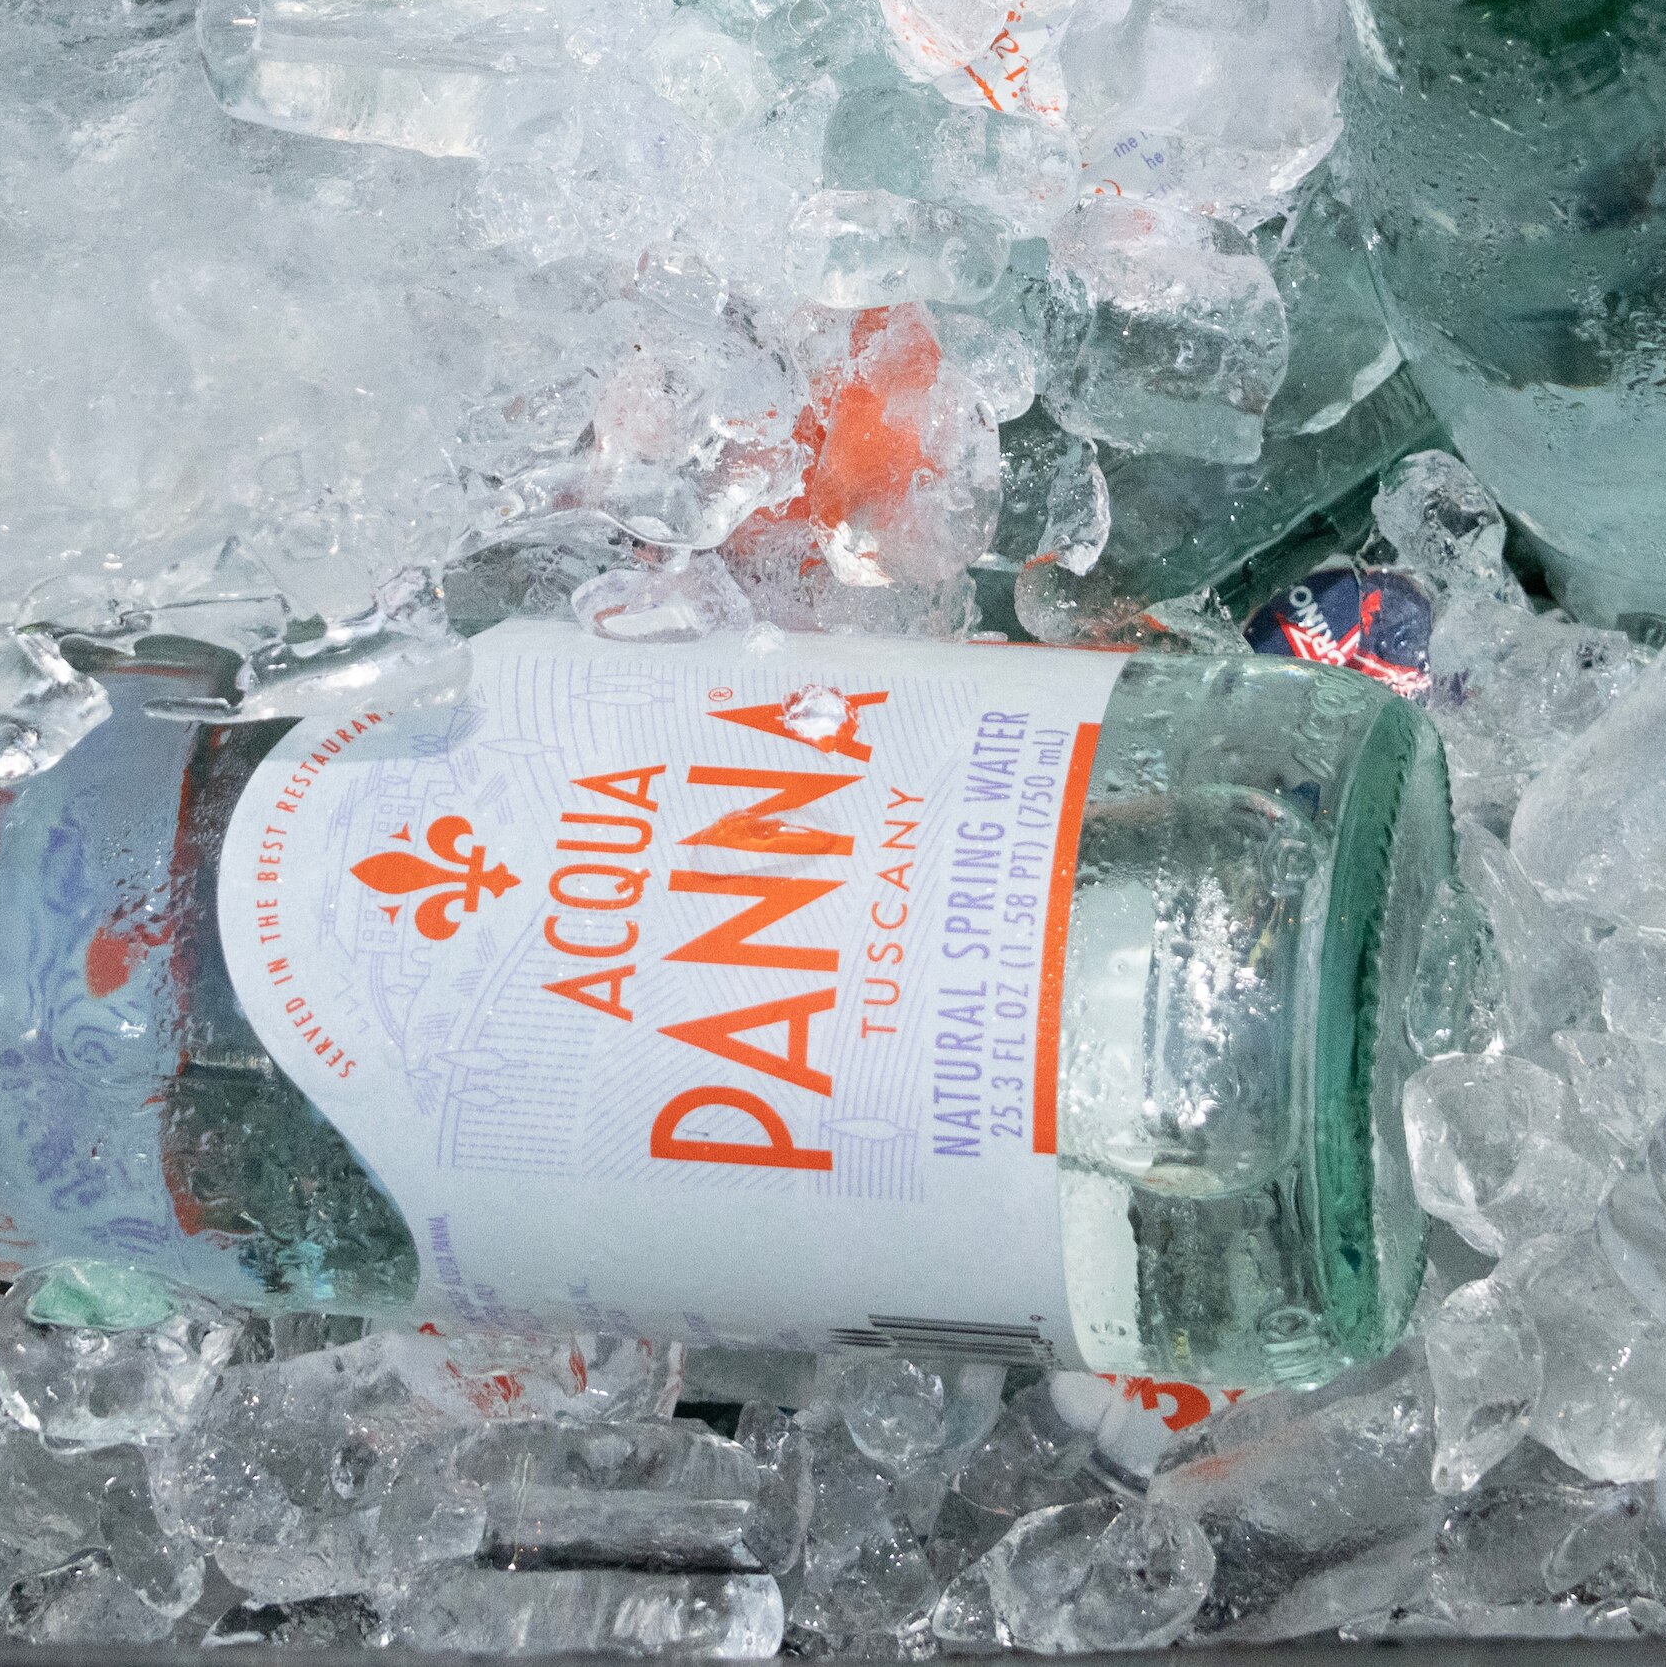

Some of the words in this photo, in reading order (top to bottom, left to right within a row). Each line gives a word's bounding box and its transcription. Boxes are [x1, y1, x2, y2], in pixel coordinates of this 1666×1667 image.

[276, 711, 394, 814] RESTAURAN
[963, 711, 1030, 803] WATER
[1033, 729, 1070, 766] mL)
[1016, 775, 1056, 828] (750
[256, 824, 288, 883] BEST
[1009, 841, 1049, 880] PT)
[256, 897, 282, 944] THE
[540, 764, 667, 1023] ACQUA
[862, 786, 925, 1038] TUSCANY
[942, 821, 1006, 959] SPRING
[650, 690, 890, 1172] PANNA
[999, 893, 1038, 968] (1.58
[267, 957, 293, 985] IN
[994, 983, 1030, 1020] OZ
[286, 996, 357, 1080] SERVED
[933, 980, 987, 1157] NATURAL
[992, 1032, 1026, 1062] FL
[990, 1075, 1024, 1138] 25.3
